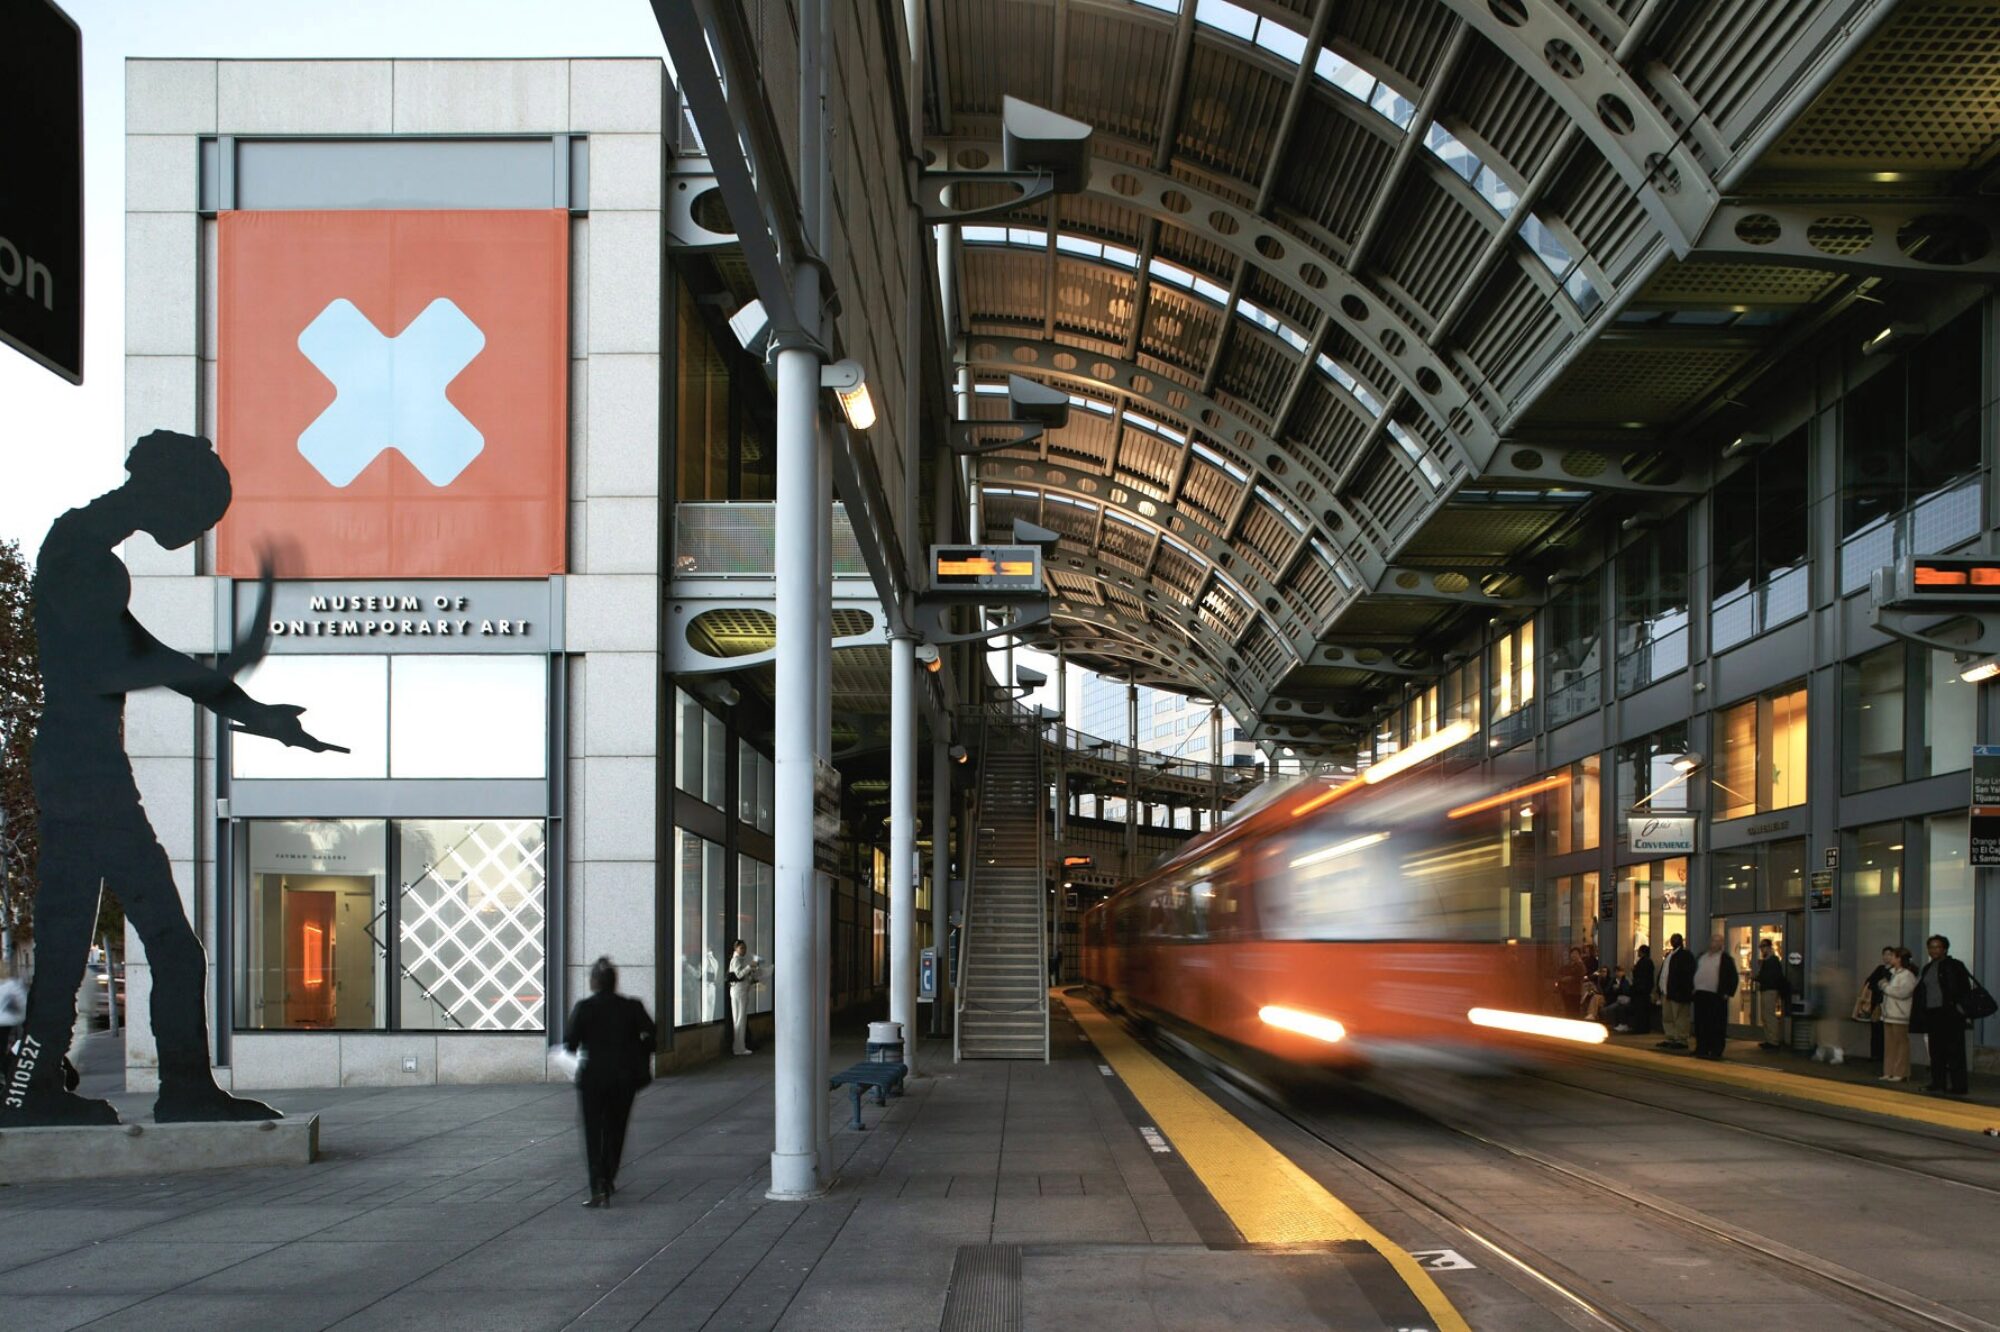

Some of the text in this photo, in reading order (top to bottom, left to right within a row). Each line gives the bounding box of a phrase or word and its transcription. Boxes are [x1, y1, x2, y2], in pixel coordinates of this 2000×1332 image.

[309, 596, 469, 611] MUSEUM OF
[269, 620, 530, 635] ONTEMPORARY ART
[1972, 837, 1997, 847] Orange
[5, 1034, 42, 1108] 3110527
